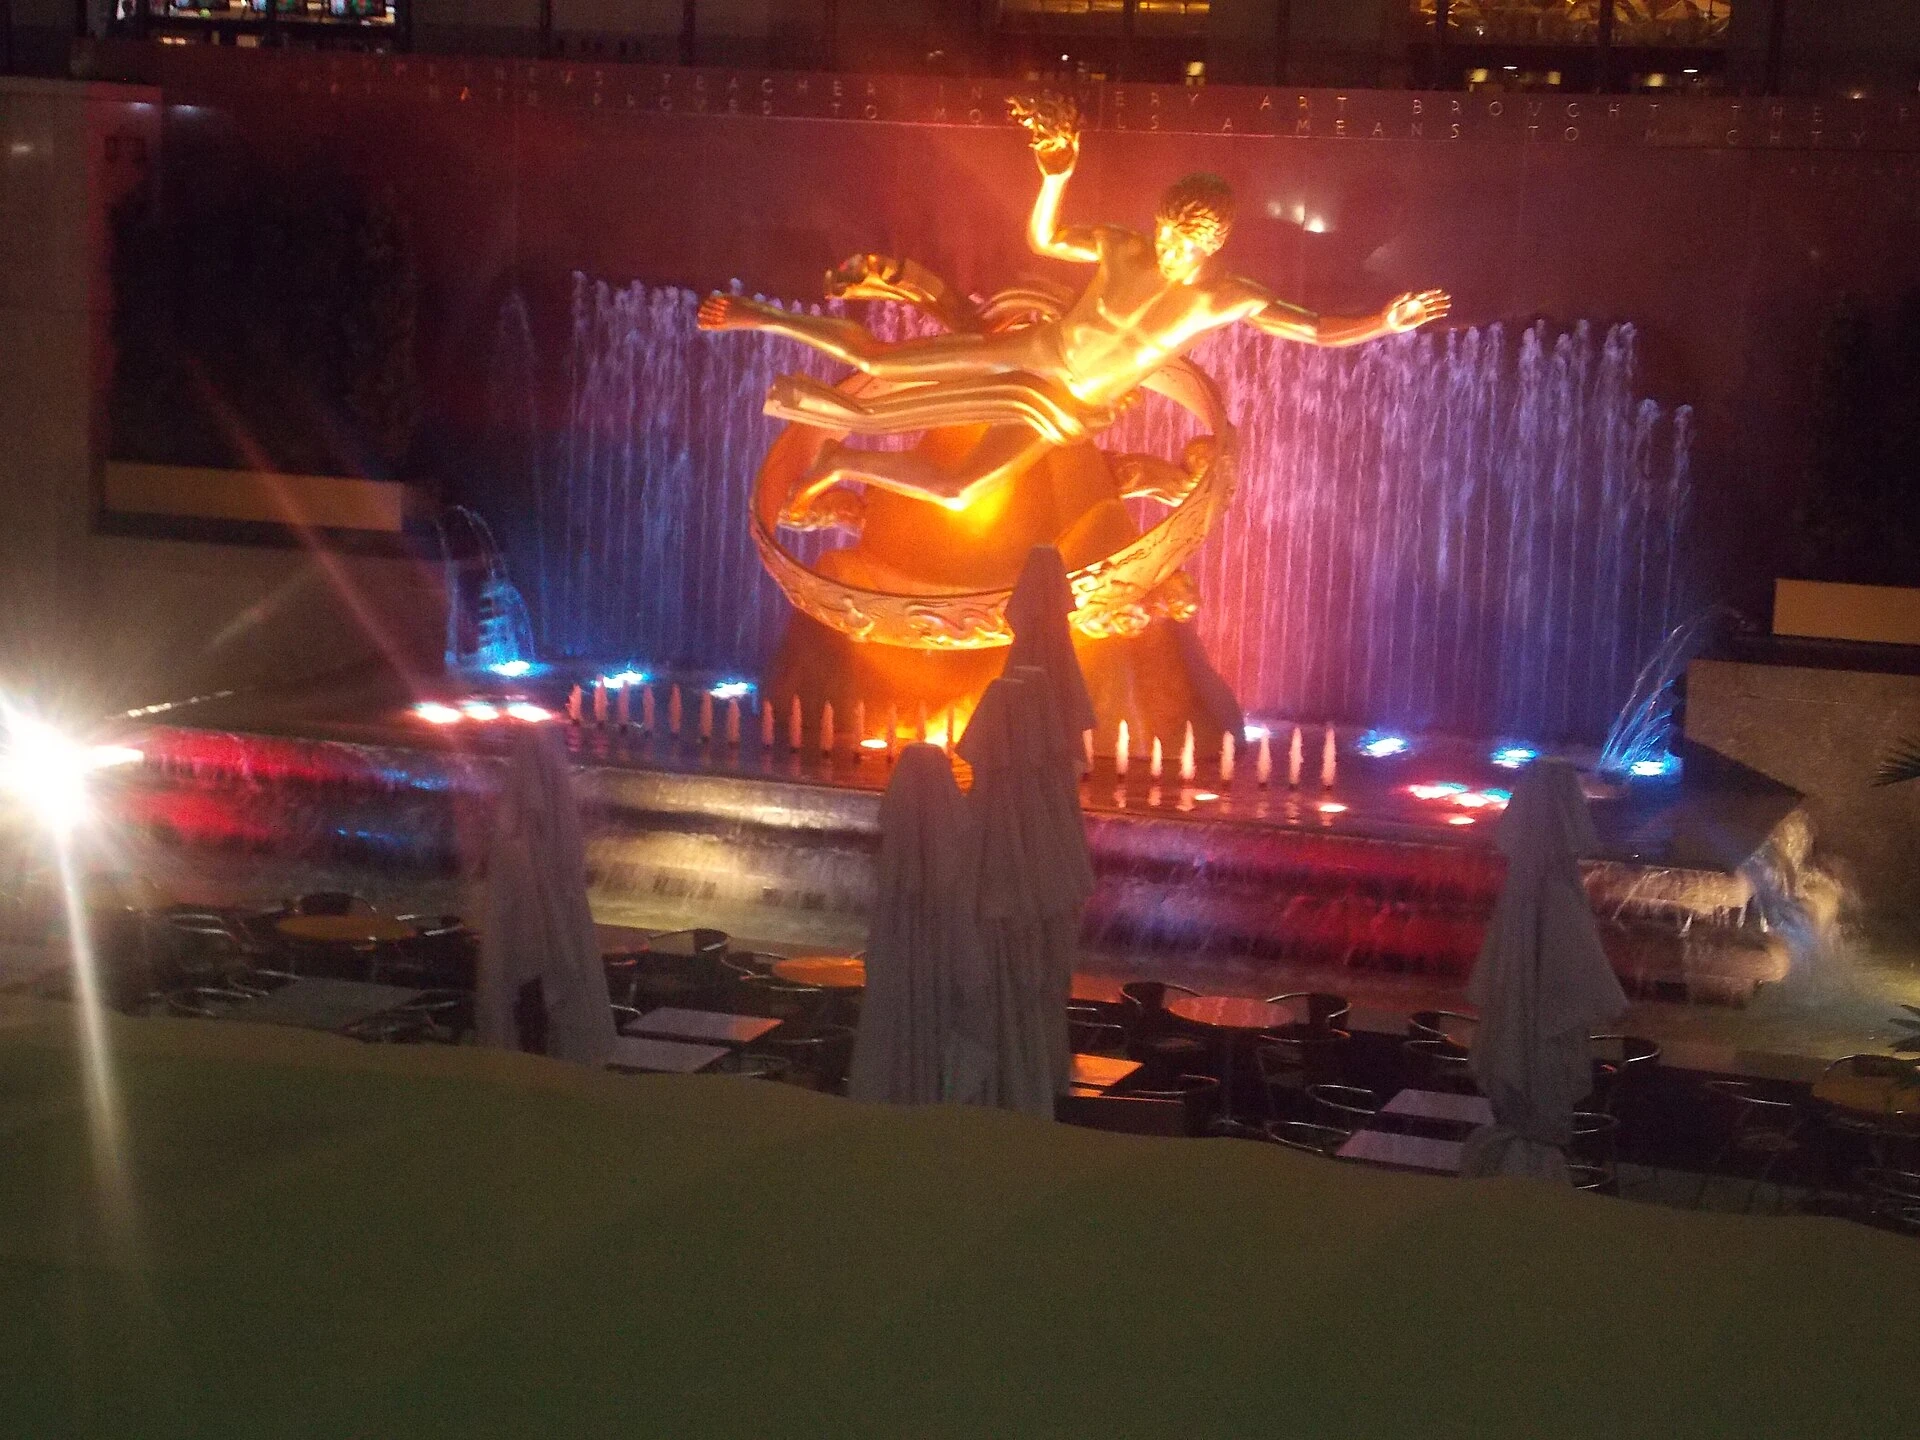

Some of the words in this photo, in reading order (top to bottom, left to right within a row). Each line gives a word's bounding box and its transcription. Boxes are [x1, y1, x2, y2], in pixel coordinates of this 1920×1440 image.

[660, 72, 876, 98] TEACHER
[936, 83, 983, 100] IN
[1259, 94, 1349, 111] ART
[1730, 104, 1824, 122] THE
[830, 101, 878, 121] TO
[1221, 117, 1234, 132] A
[1296, 118, 1461, 140] MEANS
[1527, 124, 1581, 143] TO
[1644, 127, 1867, 147] MGHTY
